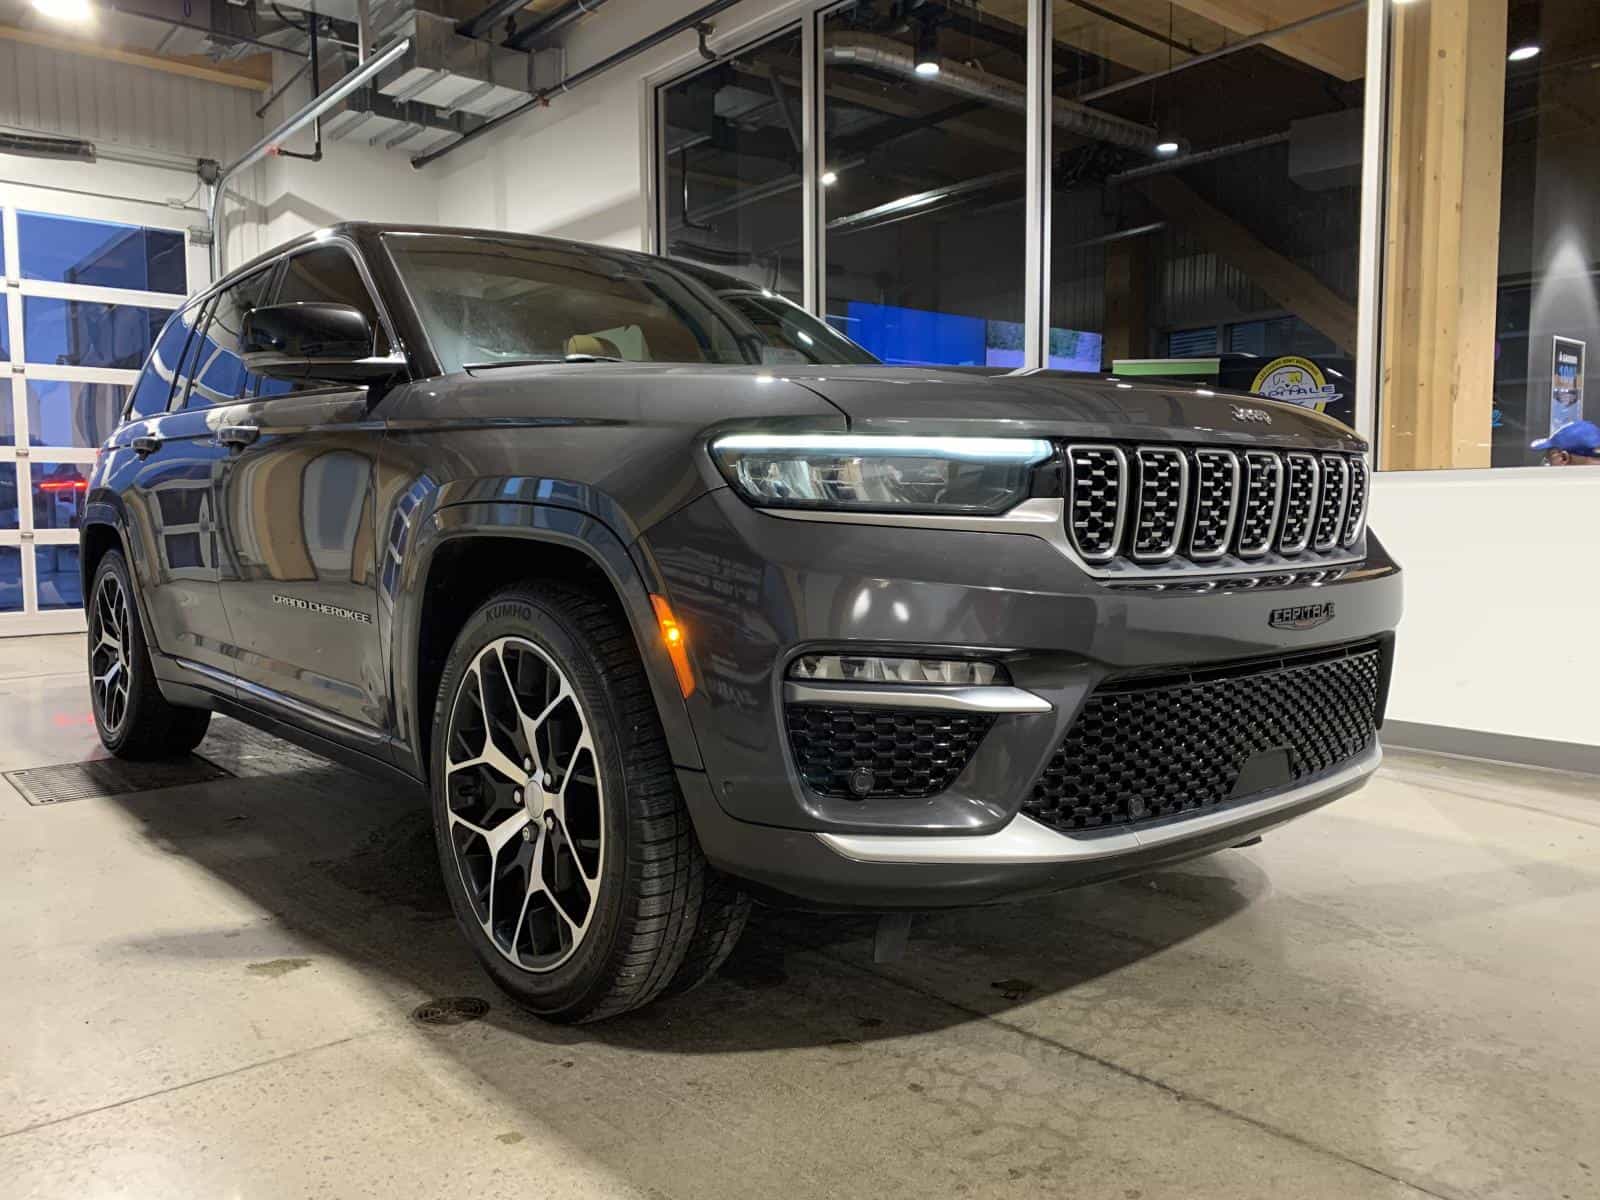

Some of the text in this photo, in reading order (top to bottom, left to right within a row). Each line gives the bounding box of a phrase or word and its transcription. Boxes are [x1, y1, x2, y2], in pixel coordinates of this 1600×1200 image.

[1258, 385, 1335, 398] APITALE
[309, 601, 372, 624] CHEROKEE
[486, 603, 532, 622] KUMHO
[1270, 603, 1335, 624] CAPITALE
